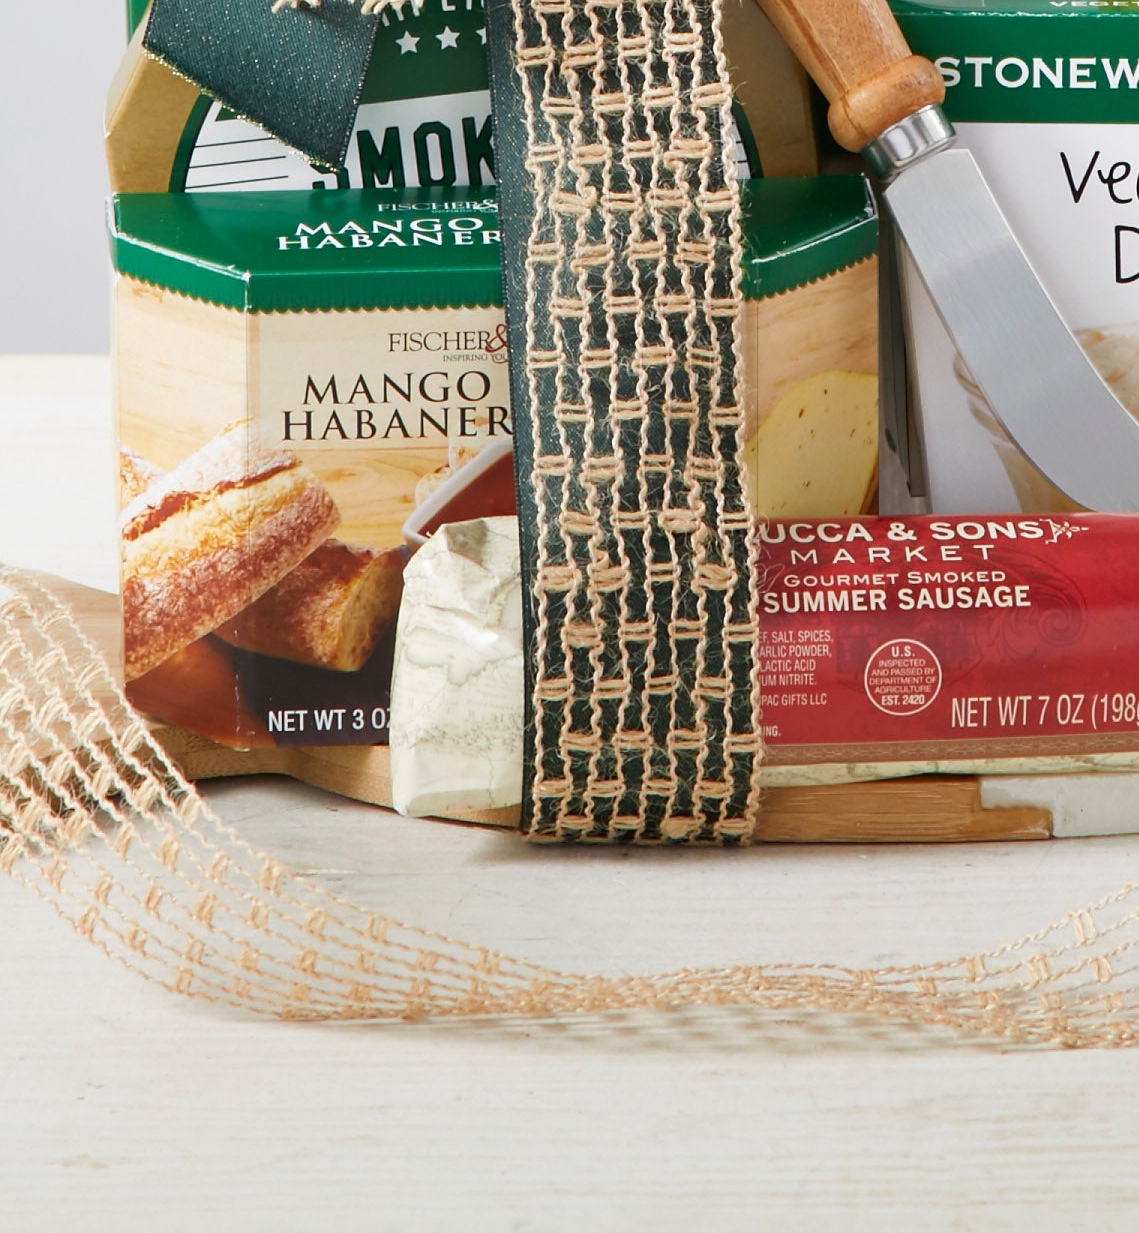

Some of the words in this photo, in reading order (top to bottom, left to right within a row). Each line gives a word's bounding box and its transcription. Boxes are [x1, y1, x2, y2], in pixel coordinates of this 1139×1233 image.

[295, 217, 483, 237] MANGO
[278, 231, 500, 250] HABANER
[443, 353, 489, 362] INSPIRING
[302, 370, 492, 405] MANGO
[281, 406, 514, 441] HABANER
[754, 522, 873, 544] UCCA
[887, 522, 917, 542] &
[929, 520, 1044, 540] SONS
[791, 544, 995, 565] MARKET
[783, 573, 899, 587] GOURMET
[907, 571, 1006, 585] SMOKED
[763, 590, 887, 614] SUMMER
[899, 585, 1031, 610] SAUSAGE
[771, 631, 796, 644] SALT,
[798, 630, 834, 643] SPICES,
[789, 645, 832, 658] POWDER,
[891, 646, 915, 657] U.S.
[760, 660, 792, 673] LACTIC
[794, 659, 816, 671] ACID
[878, 659, 926, 667] INSPECTED
[871, 668, 889, 676] AND
[890, 668, 923, 676] PASSED
[924, 667, 935, 675] BY
[779, 673, 817, 685] NITRITE.
[869, 677, 924, 685] DEPARTMENT
[925, 676, 937, 684] OF
[874, 685, 932, 693] AGRICULTURE
[760, 694, 779, 707] PAC
[782, 694, 807, 706] GIFTS
[810, 693, 827, 705] LLC
[881, 695, 900, 706] EST.
[902, 694, 925, 705] 2420
[951, 697, 992, 728] NET
[998, 696, 1032, 726] WT
[1038, 696, 1050, 725] 7
[1057, 694, 1085, 725] OZ
[268, 710, 308, 732] NET
[314, 709, 346, 731] WT
[352, 708, 365, 730] 3
